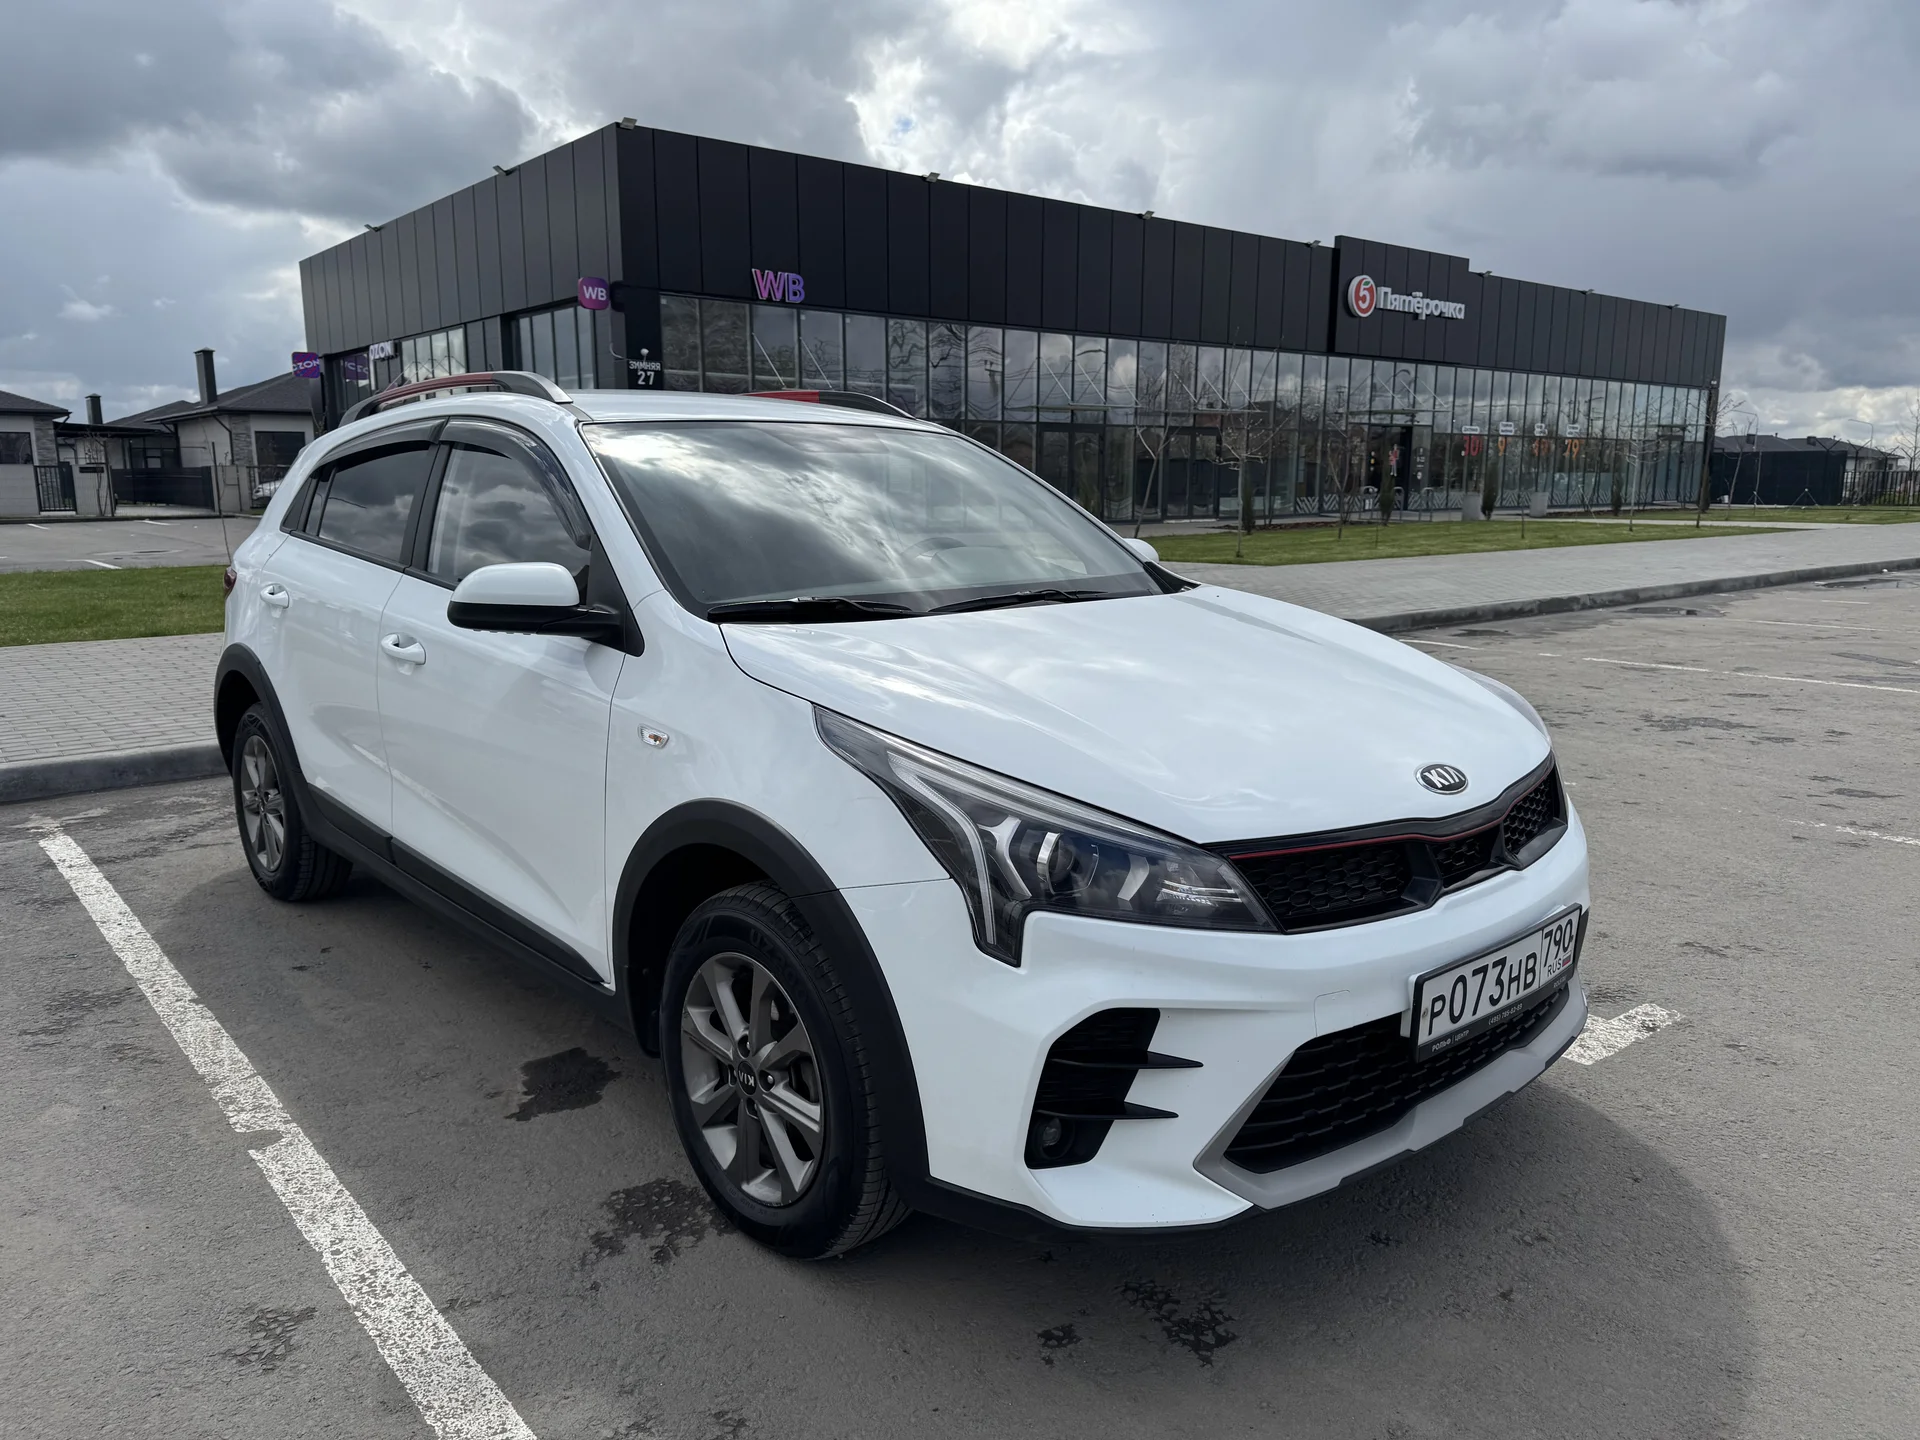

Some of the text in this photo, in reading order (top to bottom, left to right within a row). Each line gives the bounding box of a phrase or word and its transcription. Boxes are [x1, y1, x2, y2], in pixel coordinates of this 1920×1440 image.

[583, 285, 607, 301] WB
[752, 268, 805, 303] WB
[1377, 286, 1465, 320] Пятёрочка
[369, 340, 393, 361] OZON
[637, 371, 655, 386] 27
[1422, 766, 1466, 788] KIA
[1543, 918, 1573, 968] 790
[1547, 957, 1562, 977] RUS
[738, 1070, 755, 1087] KIA
